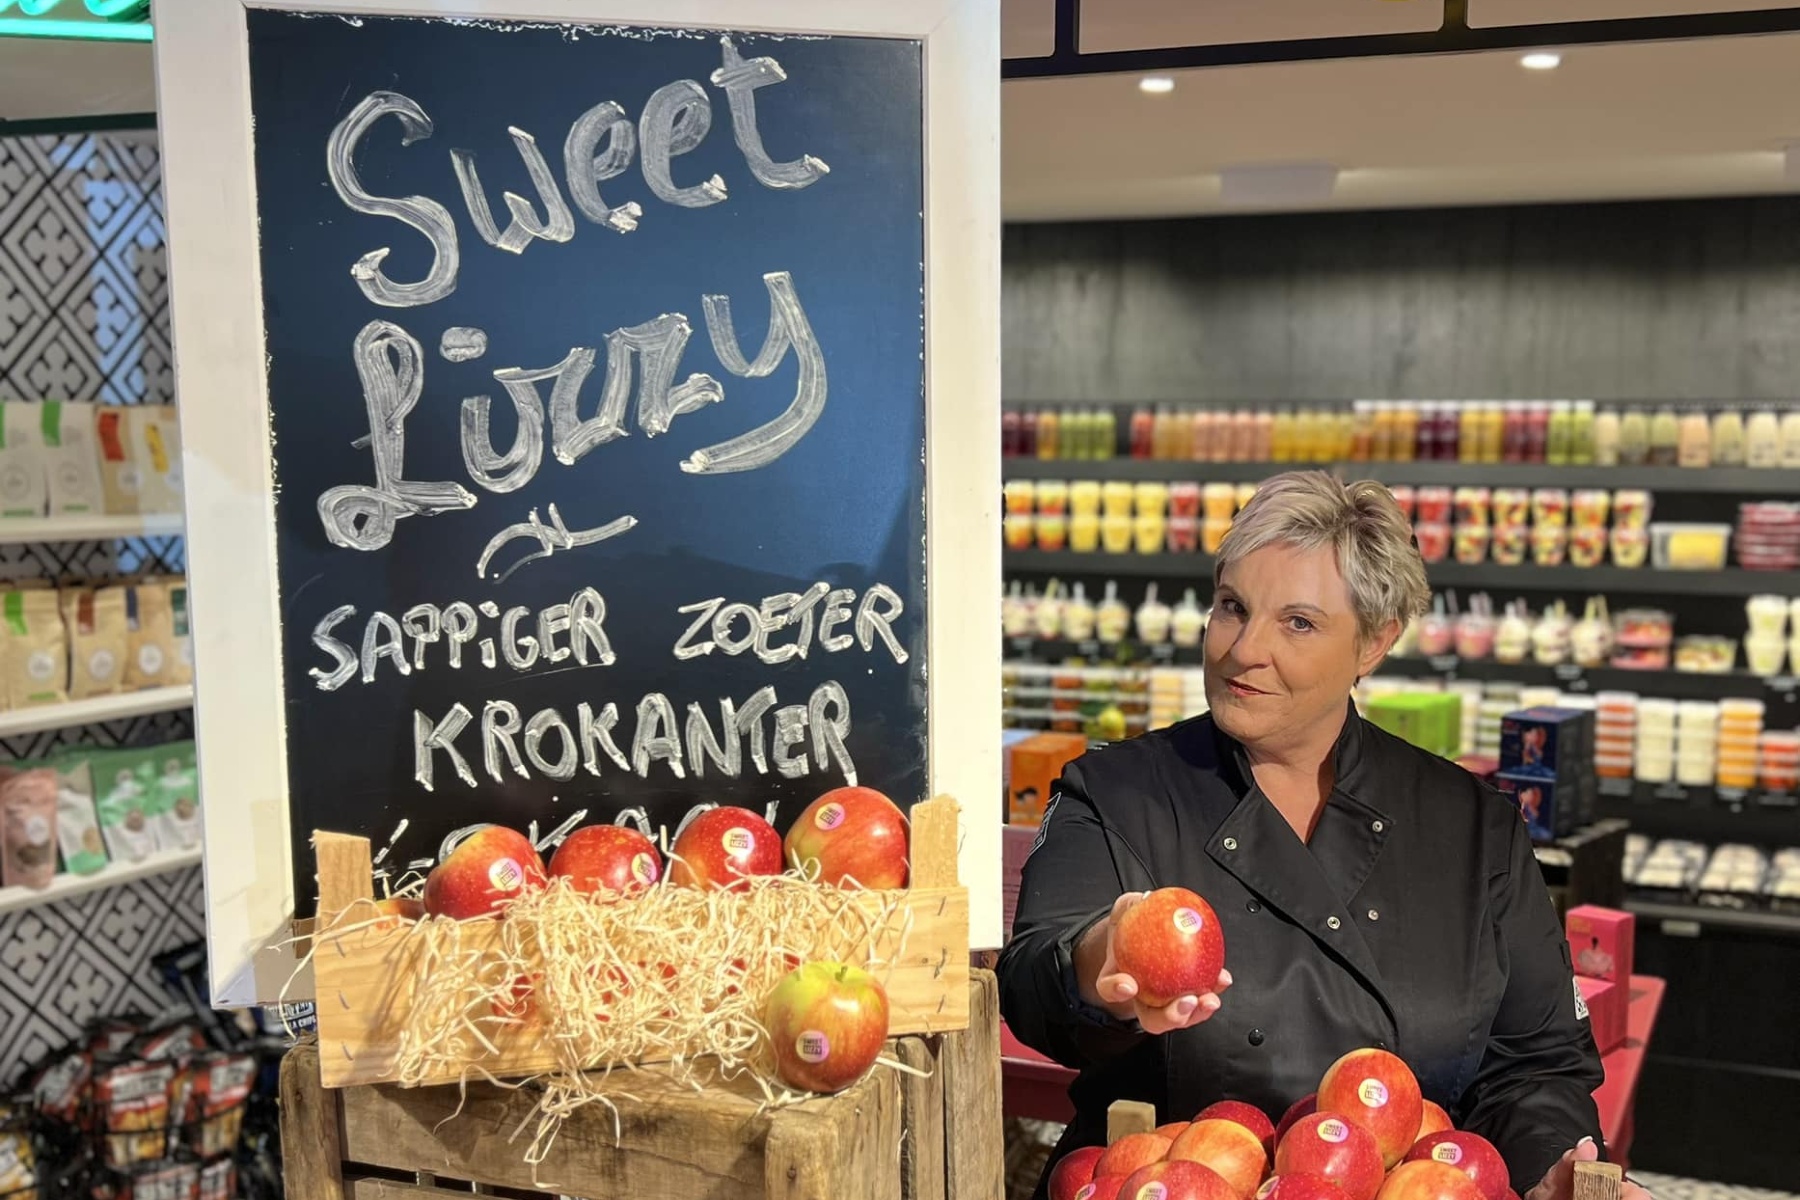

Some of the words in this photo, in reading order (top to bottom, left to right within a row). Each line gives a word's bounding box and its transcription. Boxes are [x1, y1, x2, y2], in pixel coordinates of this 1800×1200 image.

[327, 35, 830, 307] Sweet
[674, 581, 909, 665] ZOETER
[413, 680, 859, 791] KROKANTER
